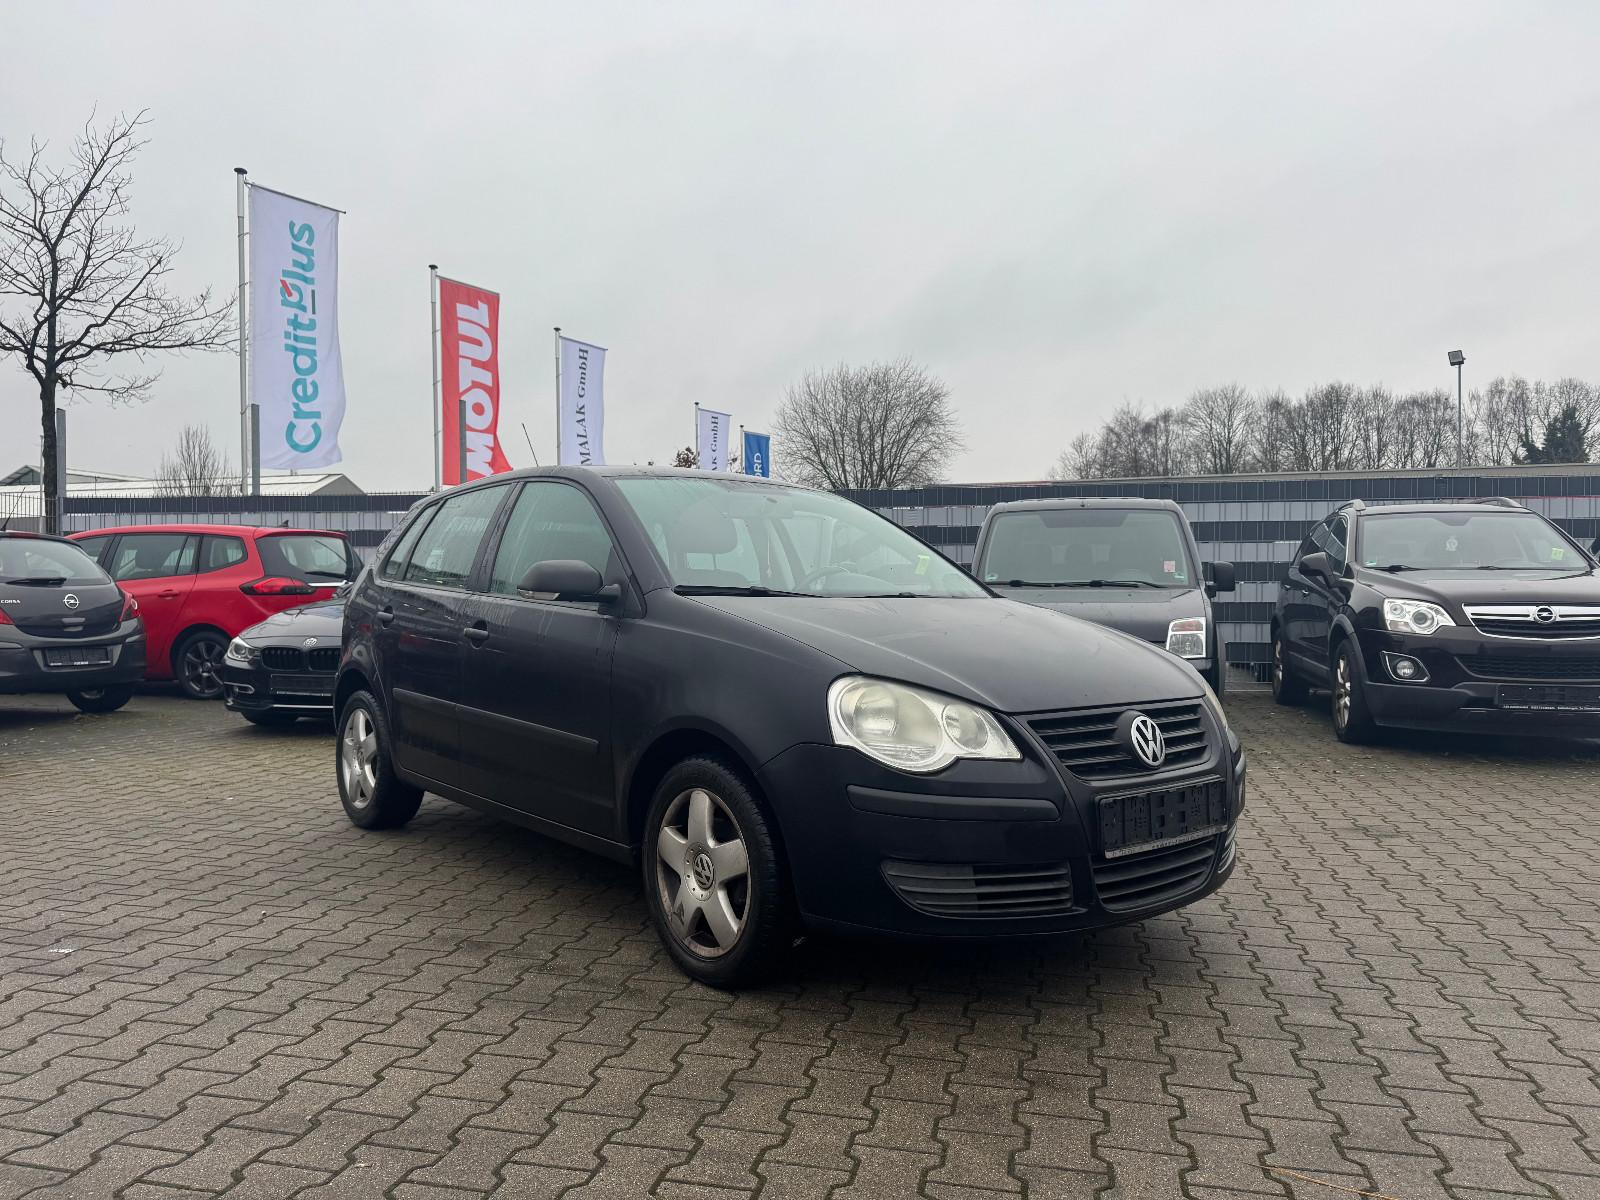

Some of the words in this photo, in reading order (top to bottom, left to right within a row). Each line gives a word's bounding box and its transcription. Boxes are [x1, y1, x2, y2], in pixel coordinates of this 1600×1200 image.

[456, 300, 494, 476] MOTUL
[576, 347, 589, 399] GmbH
[711, 415, 719, 453] GmbH
[1131, 715, 1166, 766] VW
